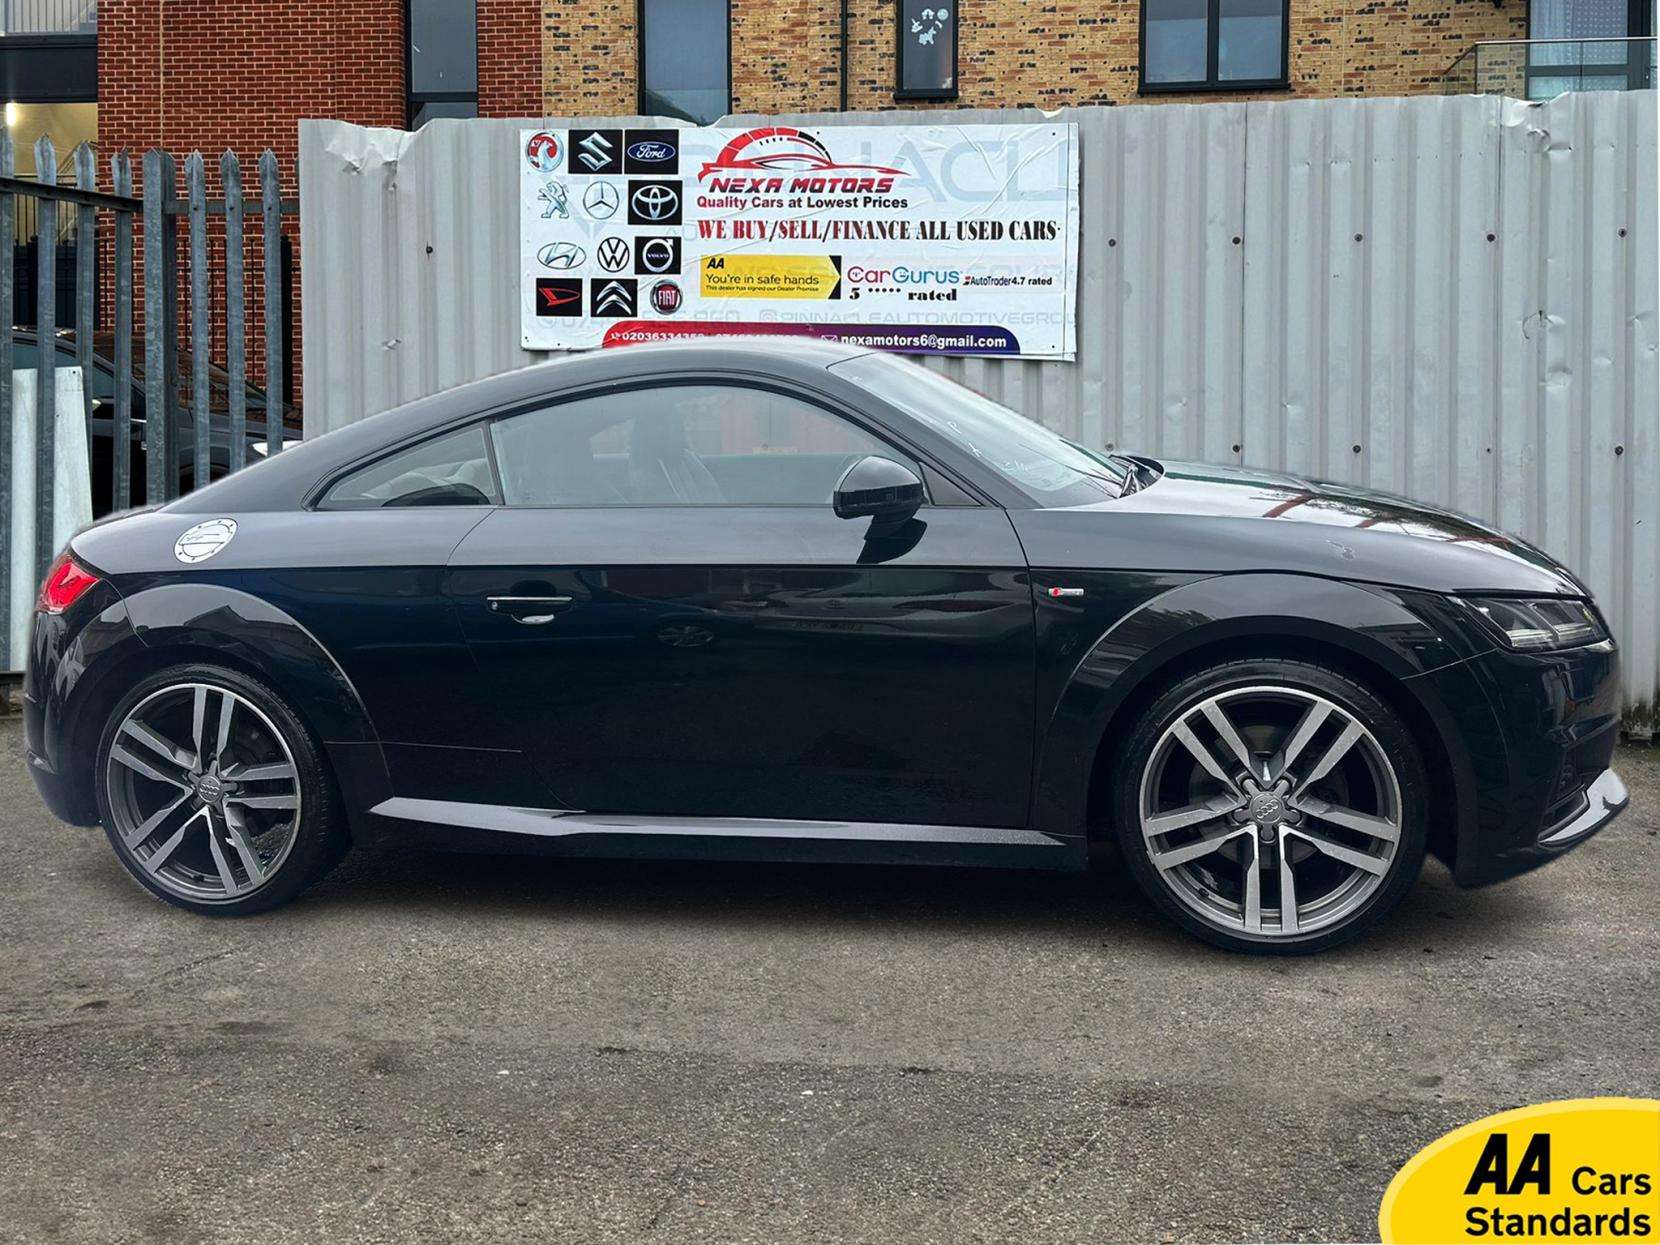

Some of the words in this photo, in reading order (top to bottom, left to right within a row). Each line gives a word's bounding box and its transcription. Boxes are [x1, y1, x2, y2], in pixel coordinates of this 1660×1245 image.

[636, 144, 666, 158] Ford
[709, 178, 784, 193] NEXA
[789, 178, 895, 193] MOTORS
[697, 196, 747, 210] Quality
[752, 196, 783, 208] Cars
[789, 197, 802, 208] at
[807, 196, 858, 208] Lowest
[863, 196, 908, 208] Prices
[697, 220, 726, 240] WE
[916, 220, 950, 240] ALL
[957, 220, 1004, 240] USED
[1009, 220, 1057, 240] CARS
[707, 257, 725, 269] AA
[706, 274, 741, 284] You're
[744, 274, 754, 284] in
[757, 274, 781, 285] safe
[781, 274, 819, 285] hands
[847, 266, 960, 284] CarGurus
[1028, 276, 1052, 286] rated
[658, 290, 676, 306] FIAT
[849, 287, 860, 300] 5
[908, 289, 957, 301] rated
[841, 335, 1007, 348] nexamotors6@gmail.com
